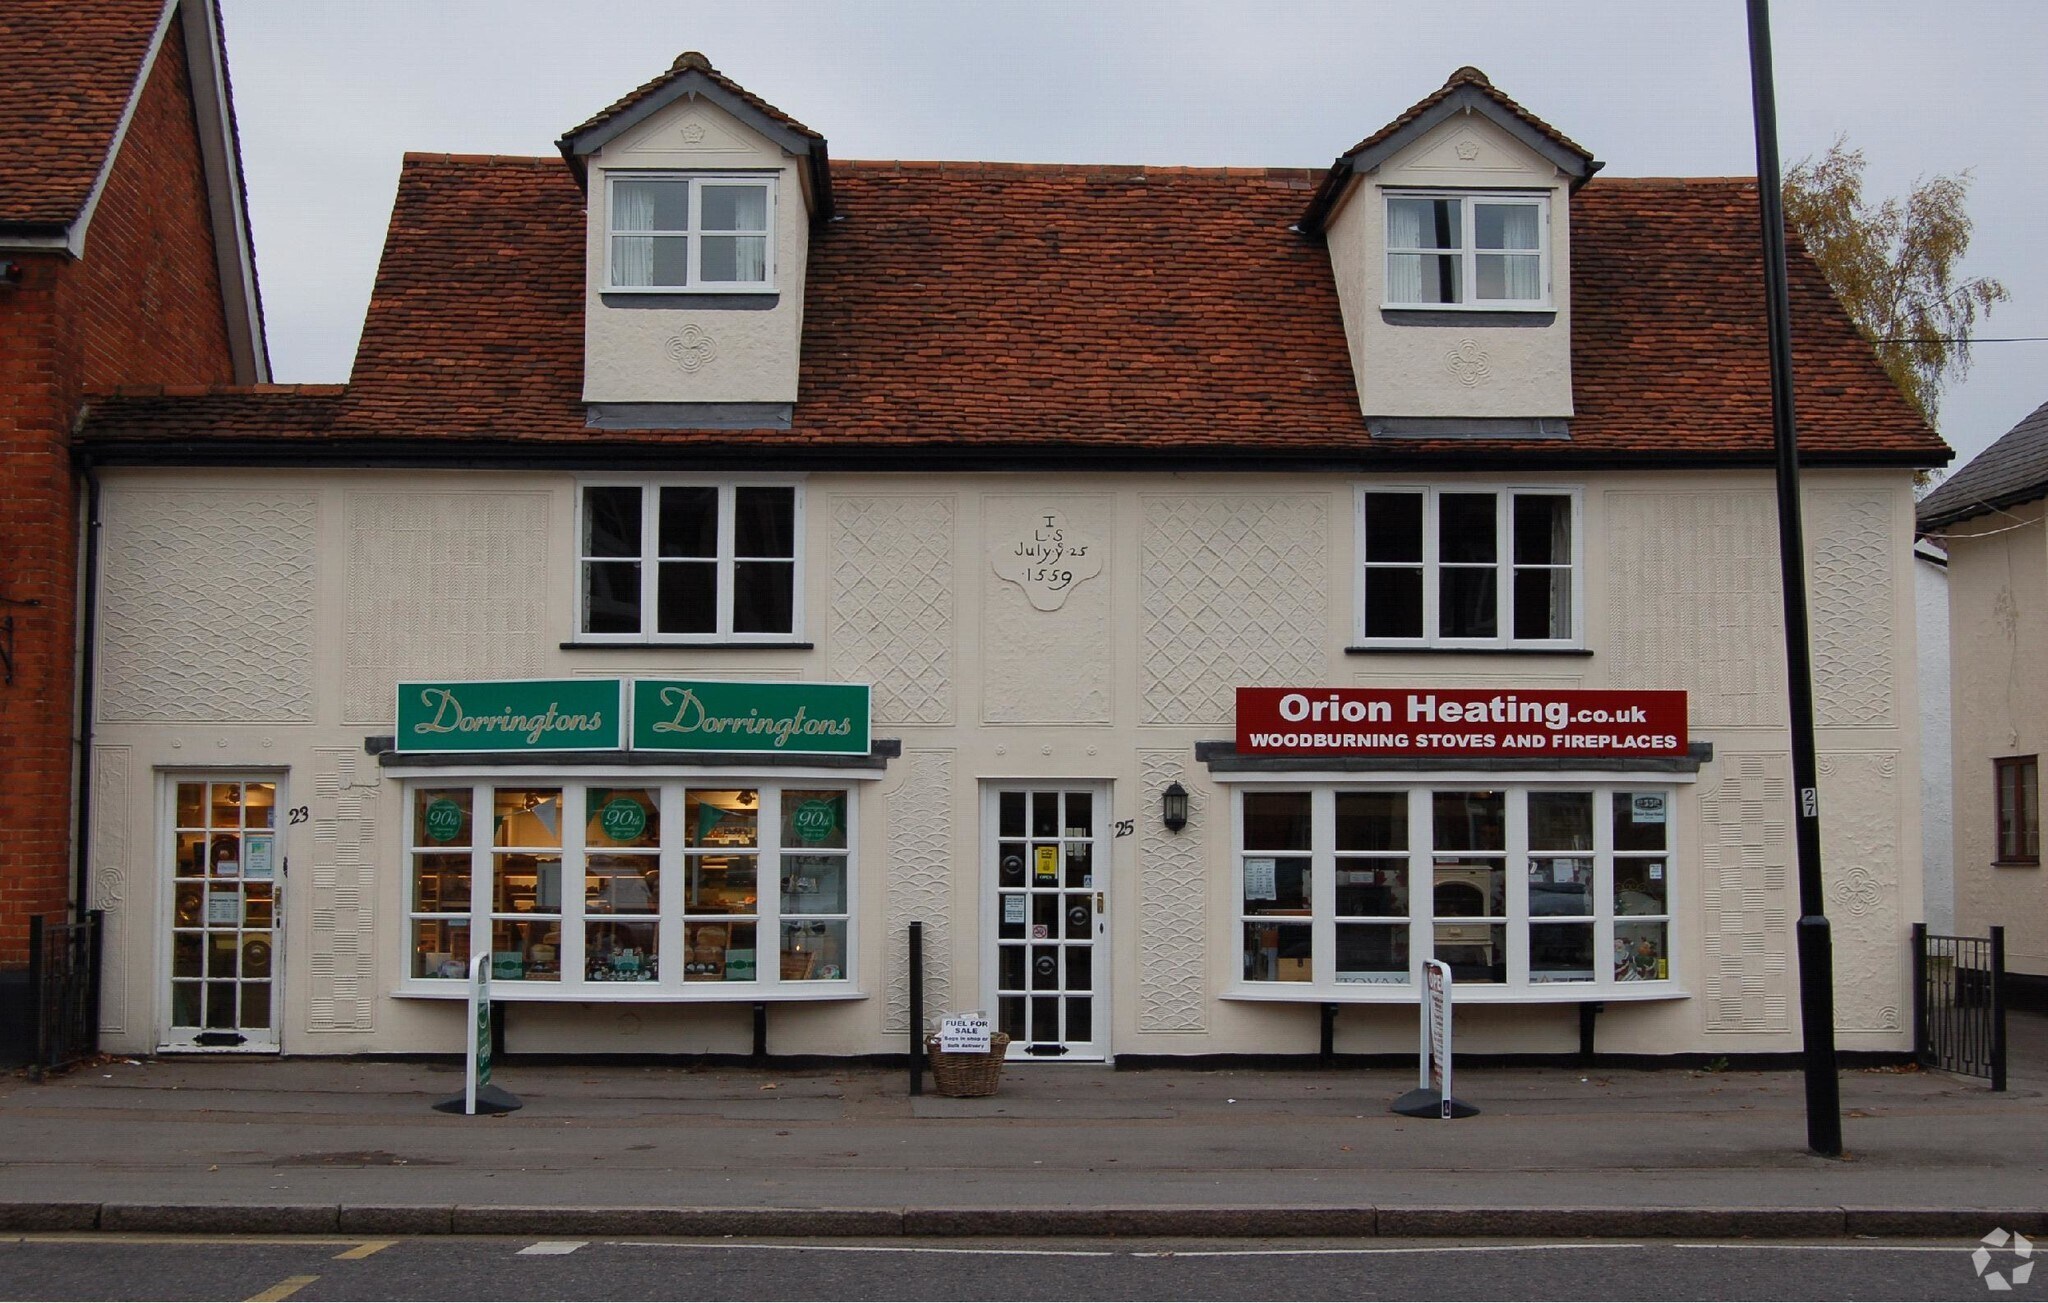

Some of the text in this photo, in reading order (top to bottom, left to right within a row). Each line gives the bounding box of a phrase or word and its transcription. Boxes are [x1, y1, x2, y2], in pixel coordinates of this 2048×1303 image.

[414, 687, 602, 744] Dorringtons
[652, 686, 851, 747] Dorringtons
[1279, 693, 1647, 730] Orion Heating.co.uk
[1250, 733, 1678, 749] WOODBURNING STOVES AND FIREPLACES
[289, 805, 309, 825] 23
[1115, 818, 1135, 838] 25
